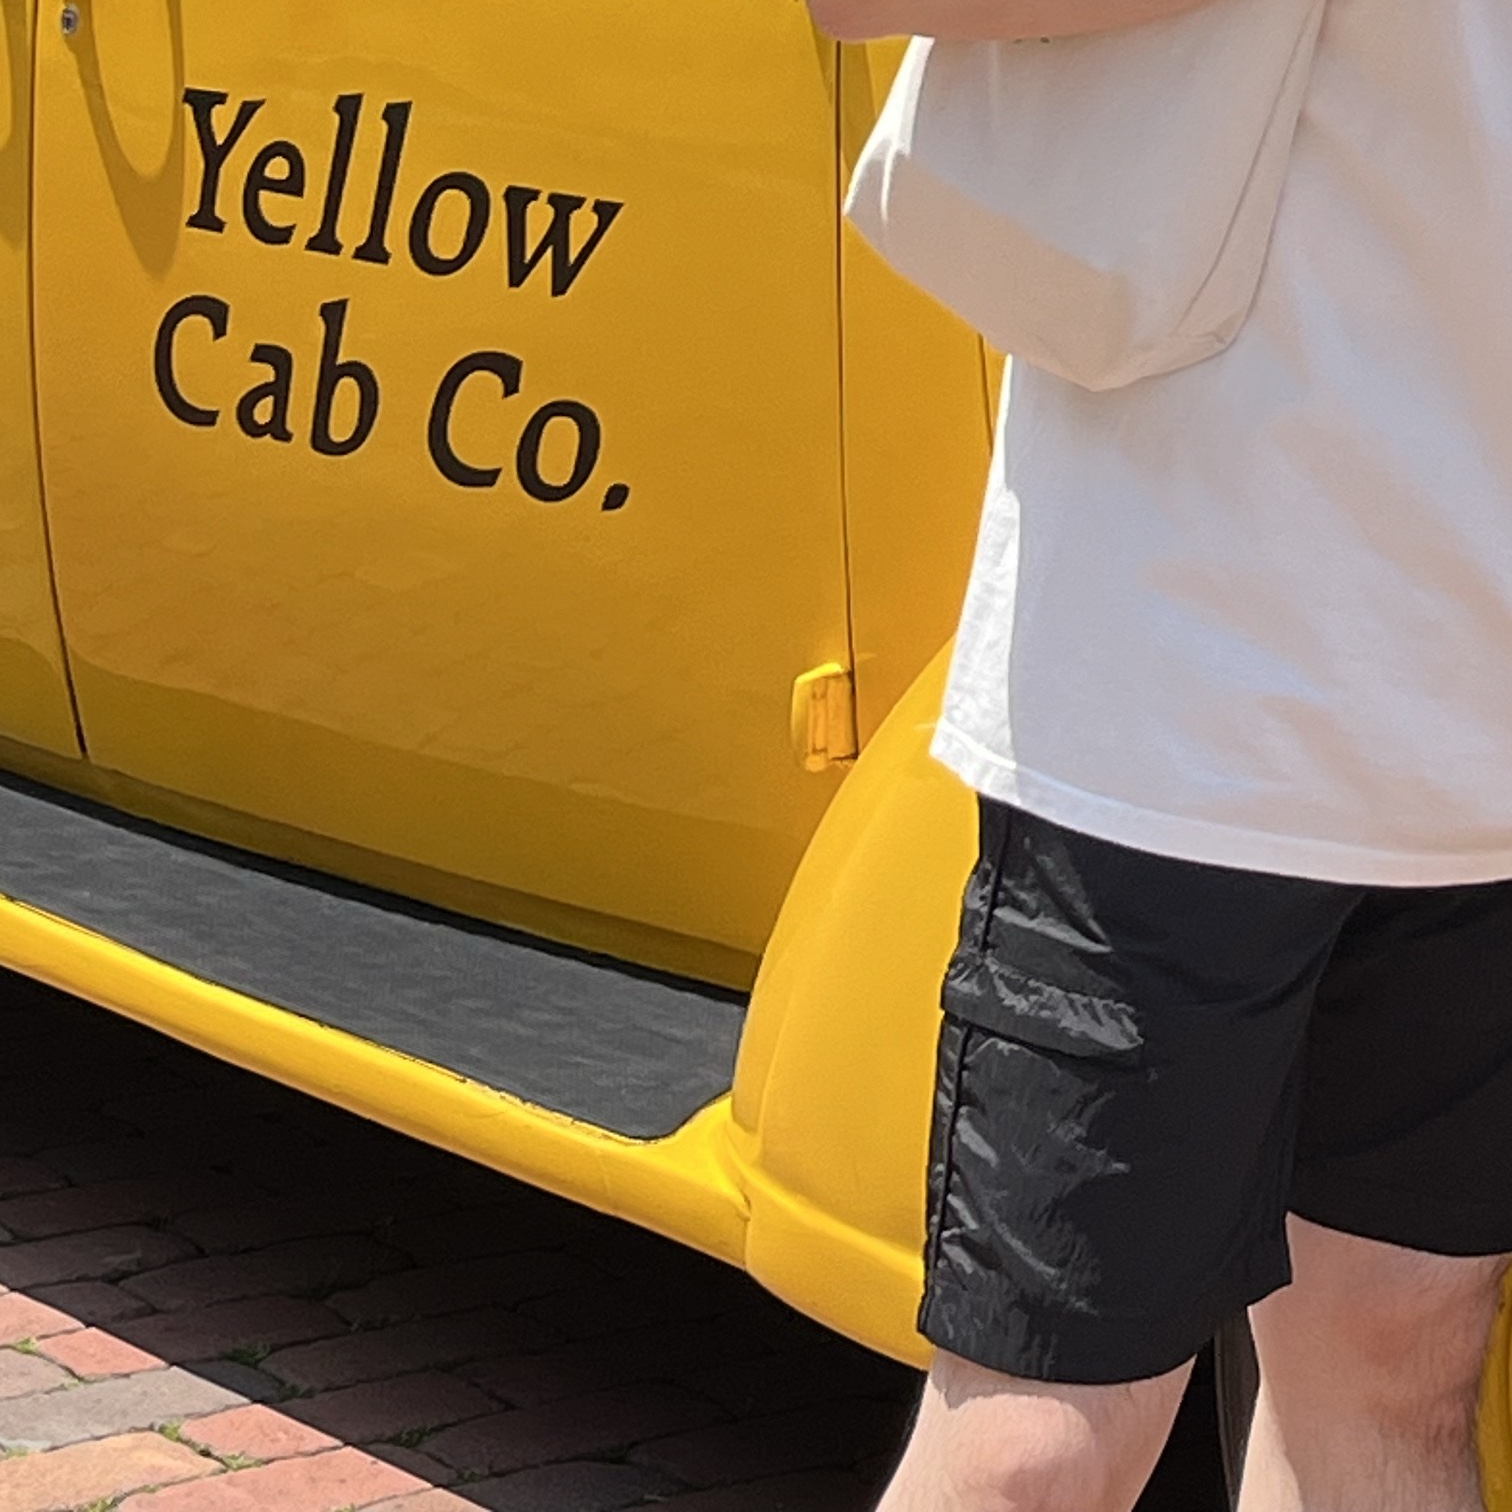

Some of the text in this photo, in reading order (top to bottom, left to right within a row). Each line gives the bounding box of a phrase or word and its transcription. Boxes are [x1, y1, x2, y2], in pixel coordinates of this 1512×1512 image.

[182, 86, 624, 297] Yellow
[153, 293, 631, 513] Cab Co.
